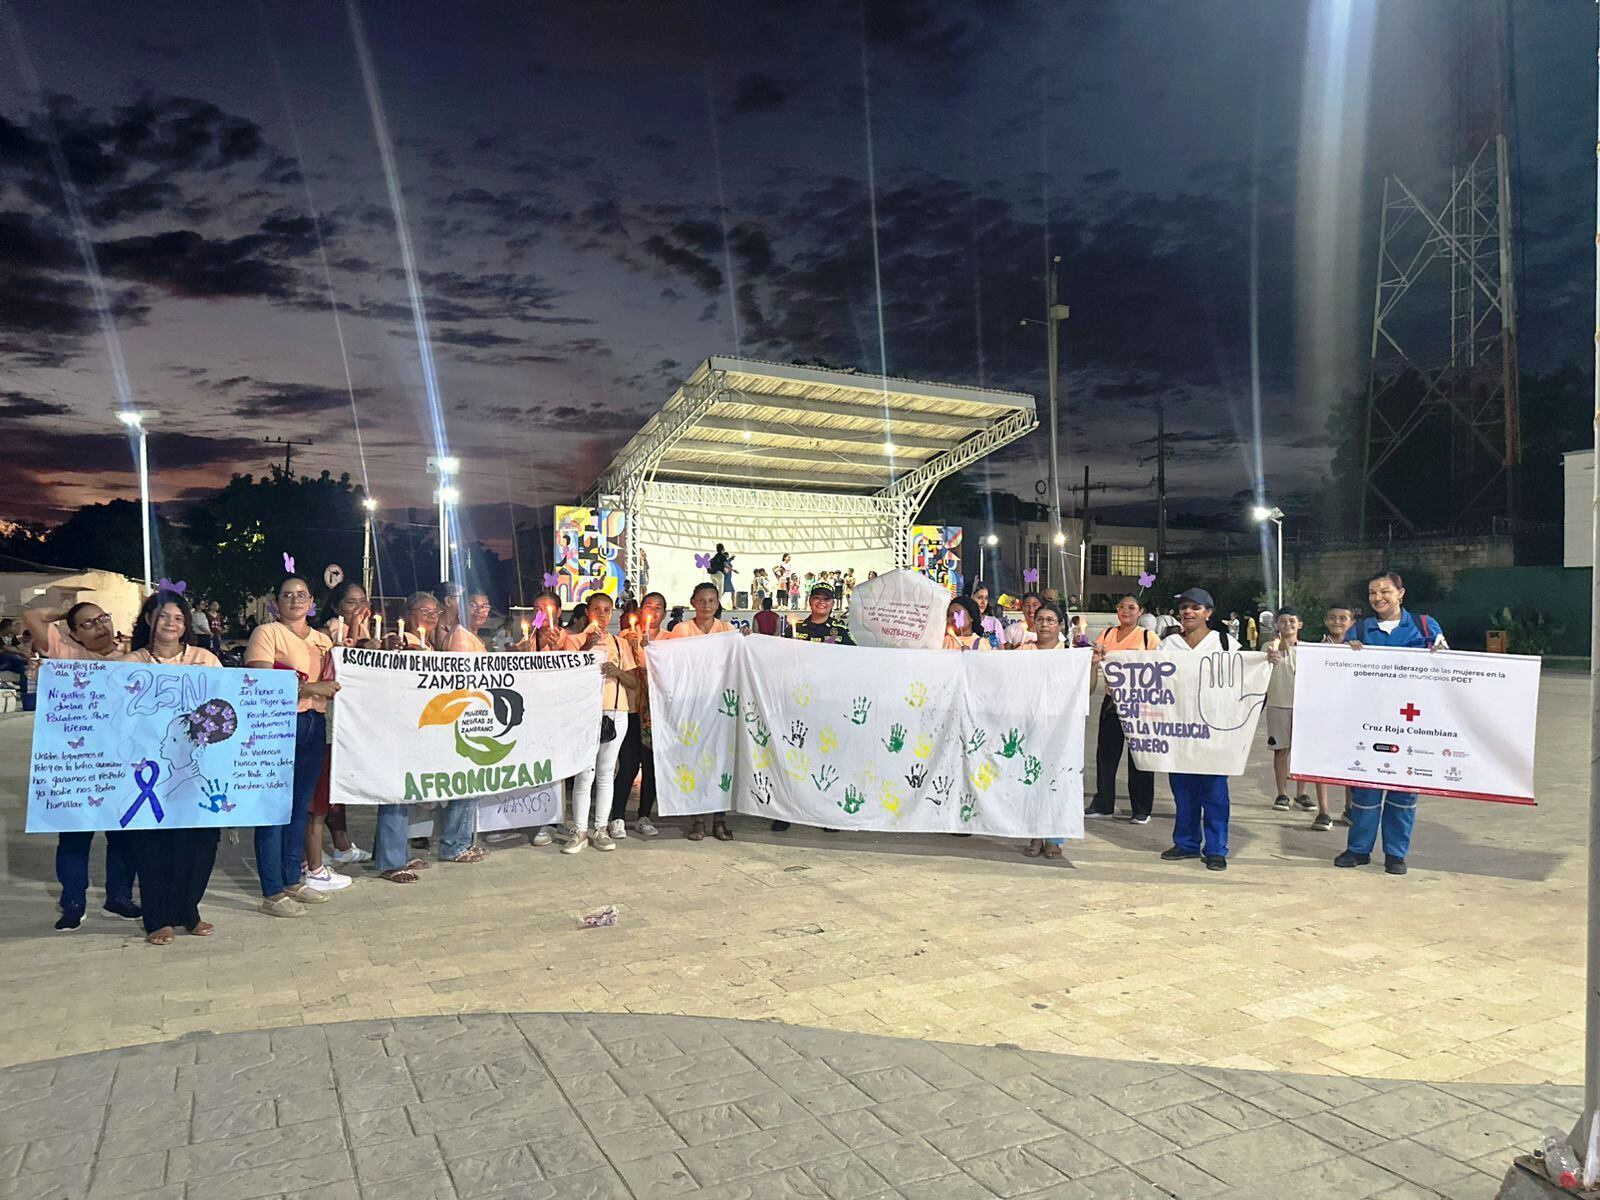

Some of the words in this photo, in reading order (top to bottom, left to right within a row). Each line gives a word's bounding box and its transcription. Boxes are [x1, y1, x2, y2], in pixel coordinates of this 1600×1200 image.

[409, 658, 421, 671] DE
[422, 655, 471, 672] MUJERES
[474, 654, 580, 672] AFRODESCENDIENTES
[583, 653, 596, 665] DE
[1325, 661, 1380, 670] Fortalecimiento
[1394, 665, 1429, 673] liderazgo
[1453, 669, 1485, 677] mujeres
[417, 673, 515, 689] ZAMBRANO
[1105, 661, 1176, 689] STOP
[1353, 671, 1397, 679] gobernanza
[1409, 674, 1450, 682] municipios
[48, 688, 59, 700] Ni
[126, 669, 208, 717] 25N
[464, 709, 488, 717] MUJERES
[462, 718, 485, 726] NEGRAS
[1137, 720, 1150, 735] LA
[1153, 721, 1210, 739] VIOLENCIA
[1362, 723, 1383, 732] Cruz
[1385, 725, 1405, 735] Roja
[1407, 727, 1458, 738] Colombiana
[404, 759, 553, 800] AFROMUZAM
